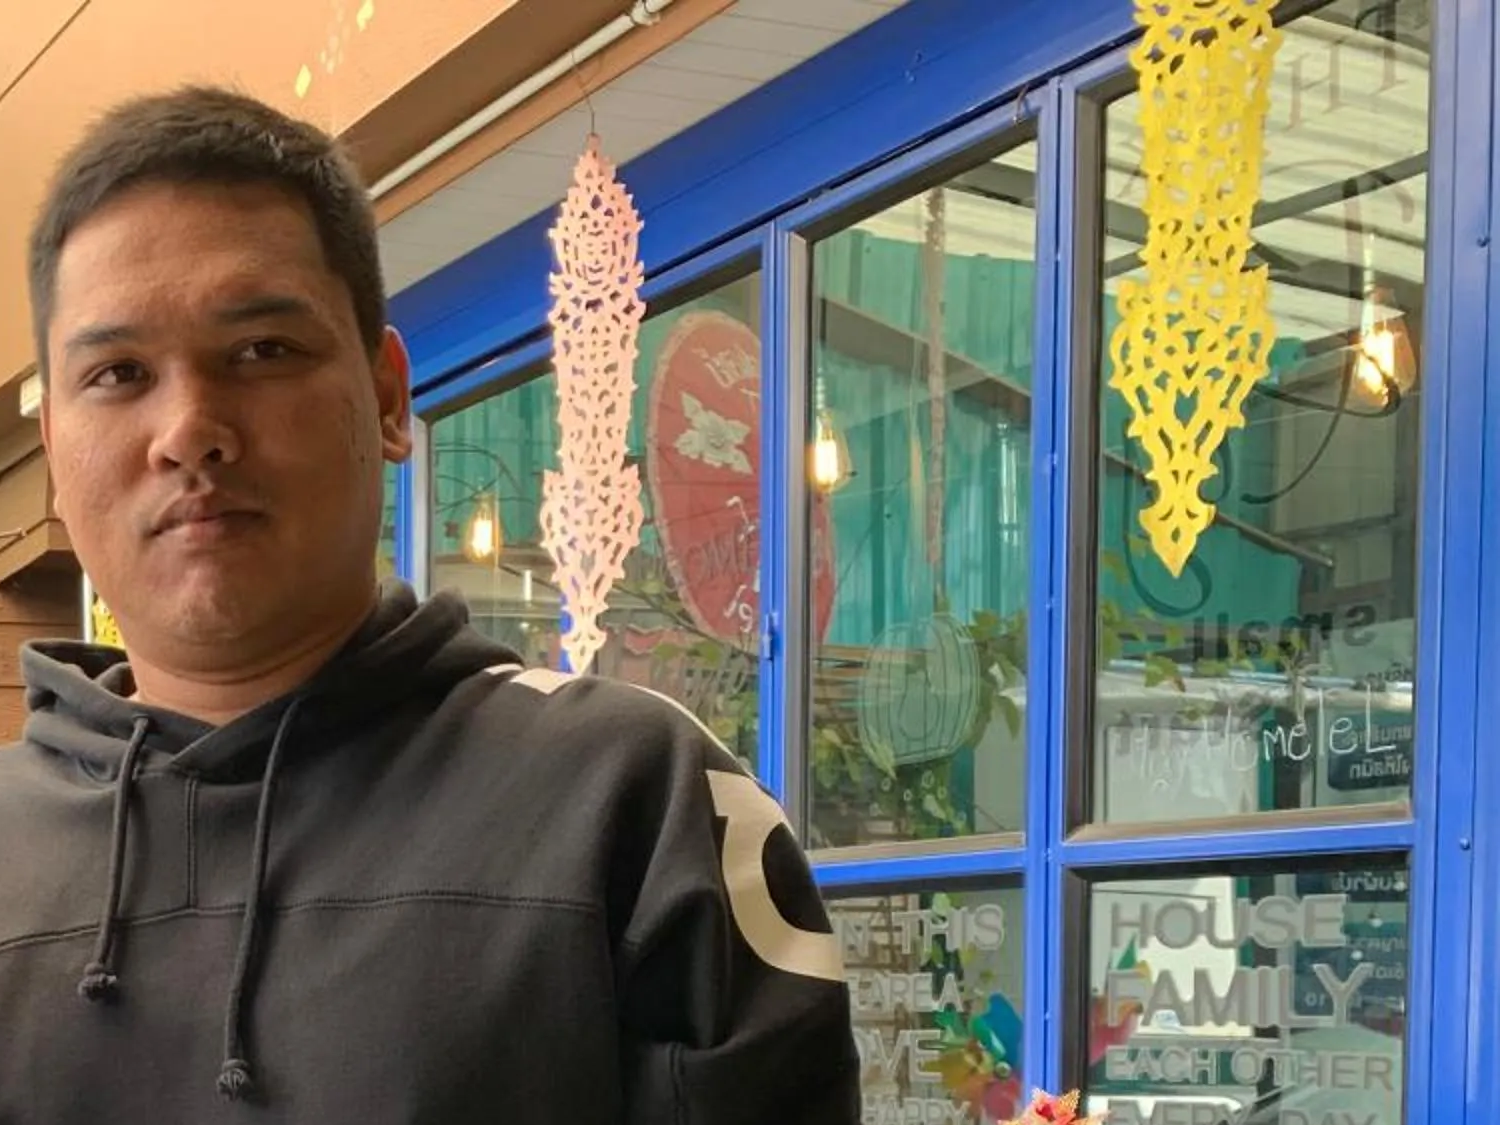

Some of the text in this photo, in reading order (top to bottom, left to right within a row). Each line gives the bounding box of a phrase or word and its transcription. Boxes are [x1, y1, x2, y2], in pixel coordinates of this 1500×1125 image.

[891, 903, 1005, 955] THIS
[1110, 894, 1348, 950] HOUSE
[1107, 962, 1377, 1027] FAMILY
[1106, 1046, 1219, 1084] EACH
[1231, 1048, 1394, 1091] OTHER
